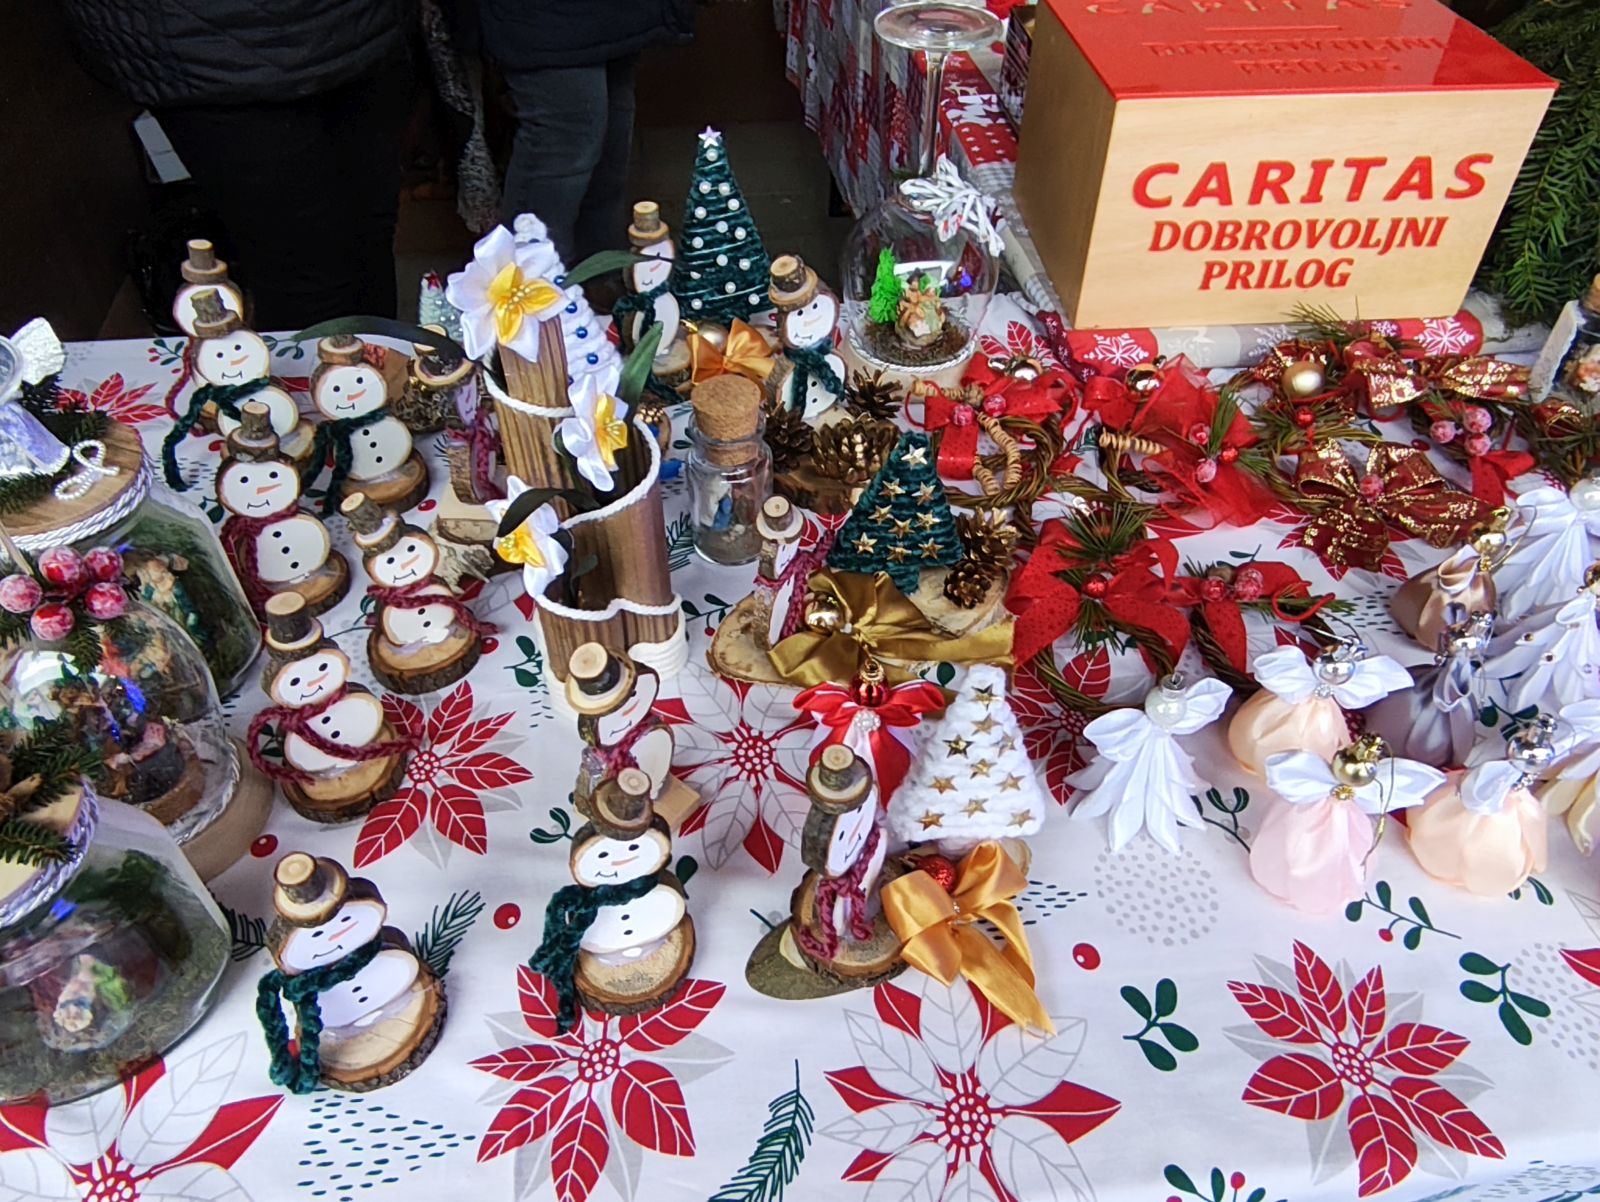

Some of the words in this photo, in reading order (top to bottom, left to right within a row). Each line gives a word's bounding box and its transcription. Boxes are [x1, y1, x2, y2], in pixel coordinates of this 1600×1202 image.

[1132, 153, 1494, 208] CARITAS
[1148, 216, 1449, 256] DOBROVOLJNI
[1198, 257, 1355, 290] PRILOG
